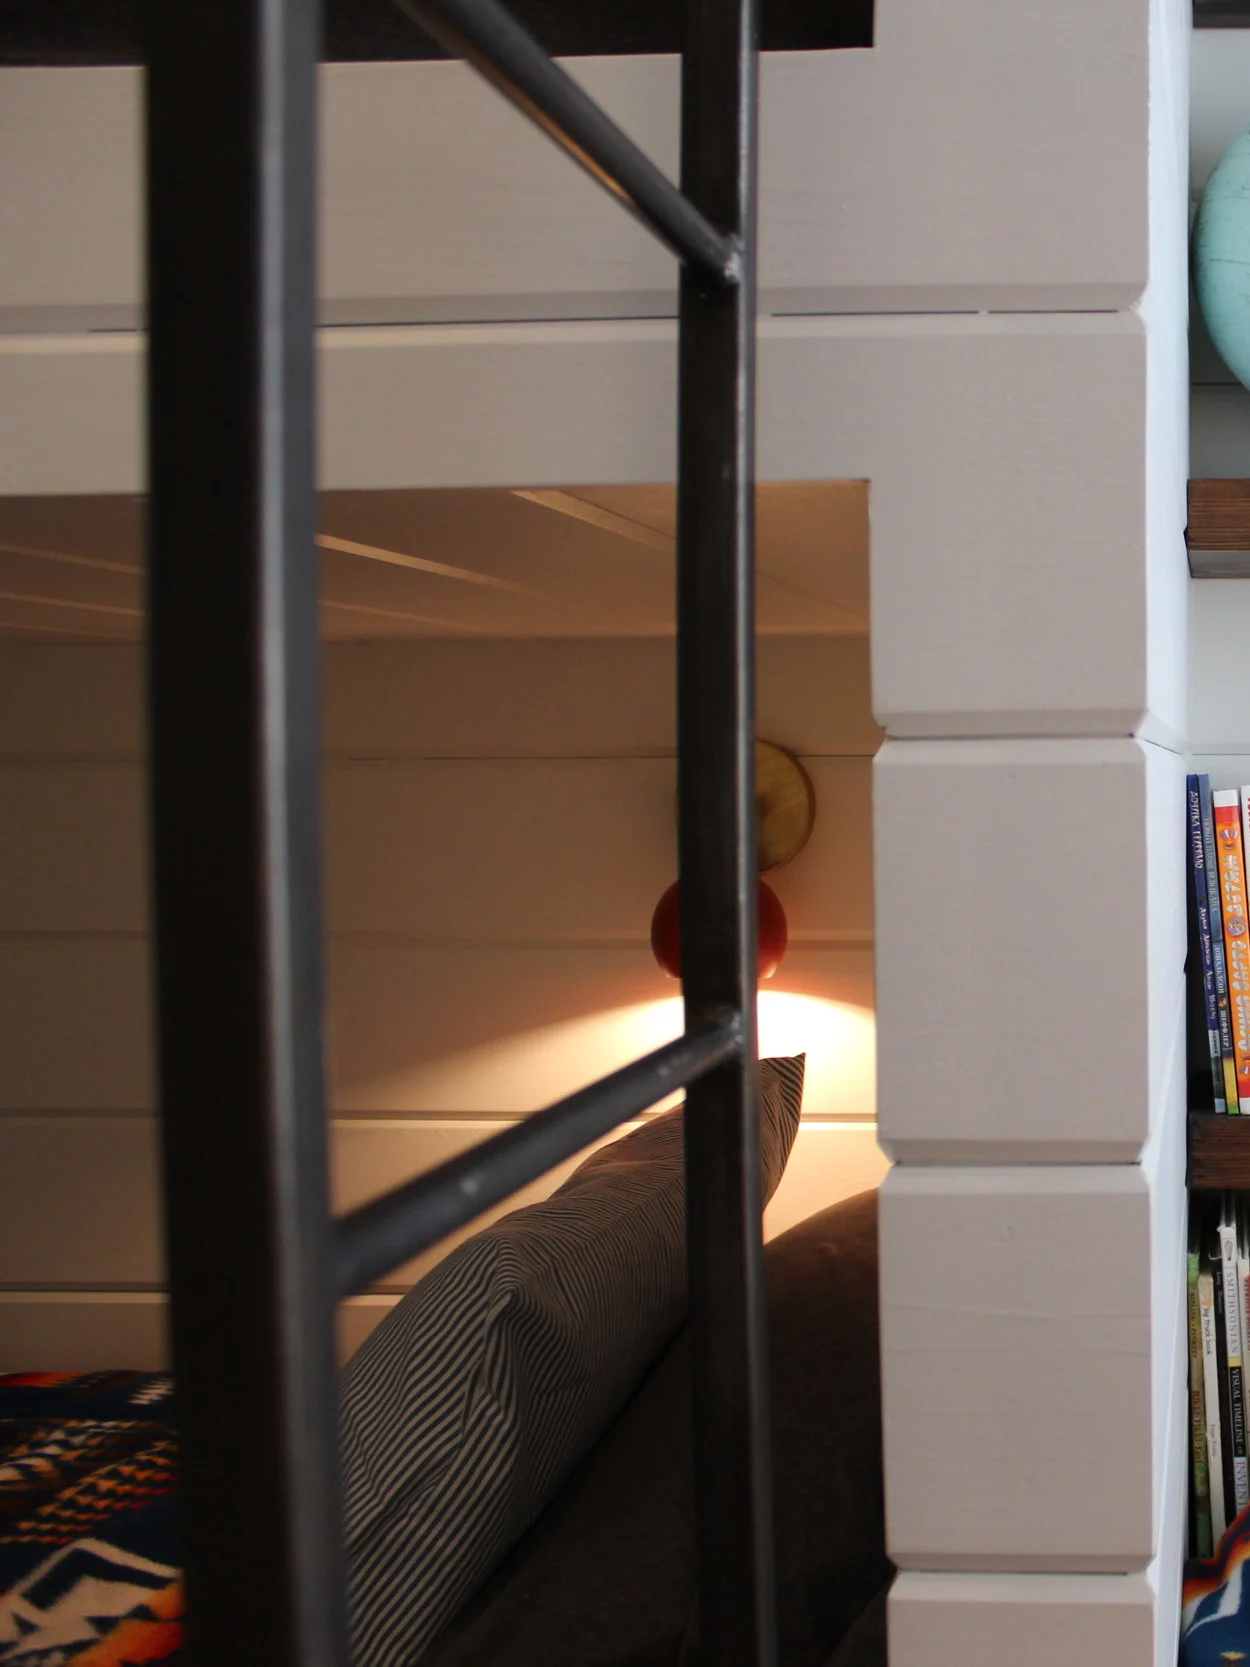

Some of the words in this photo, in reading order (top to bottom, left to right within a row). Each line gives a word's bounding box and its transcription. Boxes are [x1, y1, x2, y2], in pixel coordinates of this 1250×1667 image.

[1222, 854, 1243, 917] ДЕТЯМ
[1231, 940, 1250, 992] БАРТО
[1220, 1009, 1230, 1048] ШЕФФЛЕР
[1226, 1271, 1238, 1354] SMITHSONIAN
[1231, 1367, 1241, 1401] VISUAL
[1233, 1402, 1243, 1444] TIMELINE
[1235, 1461, 1249, 1509] INVENT
